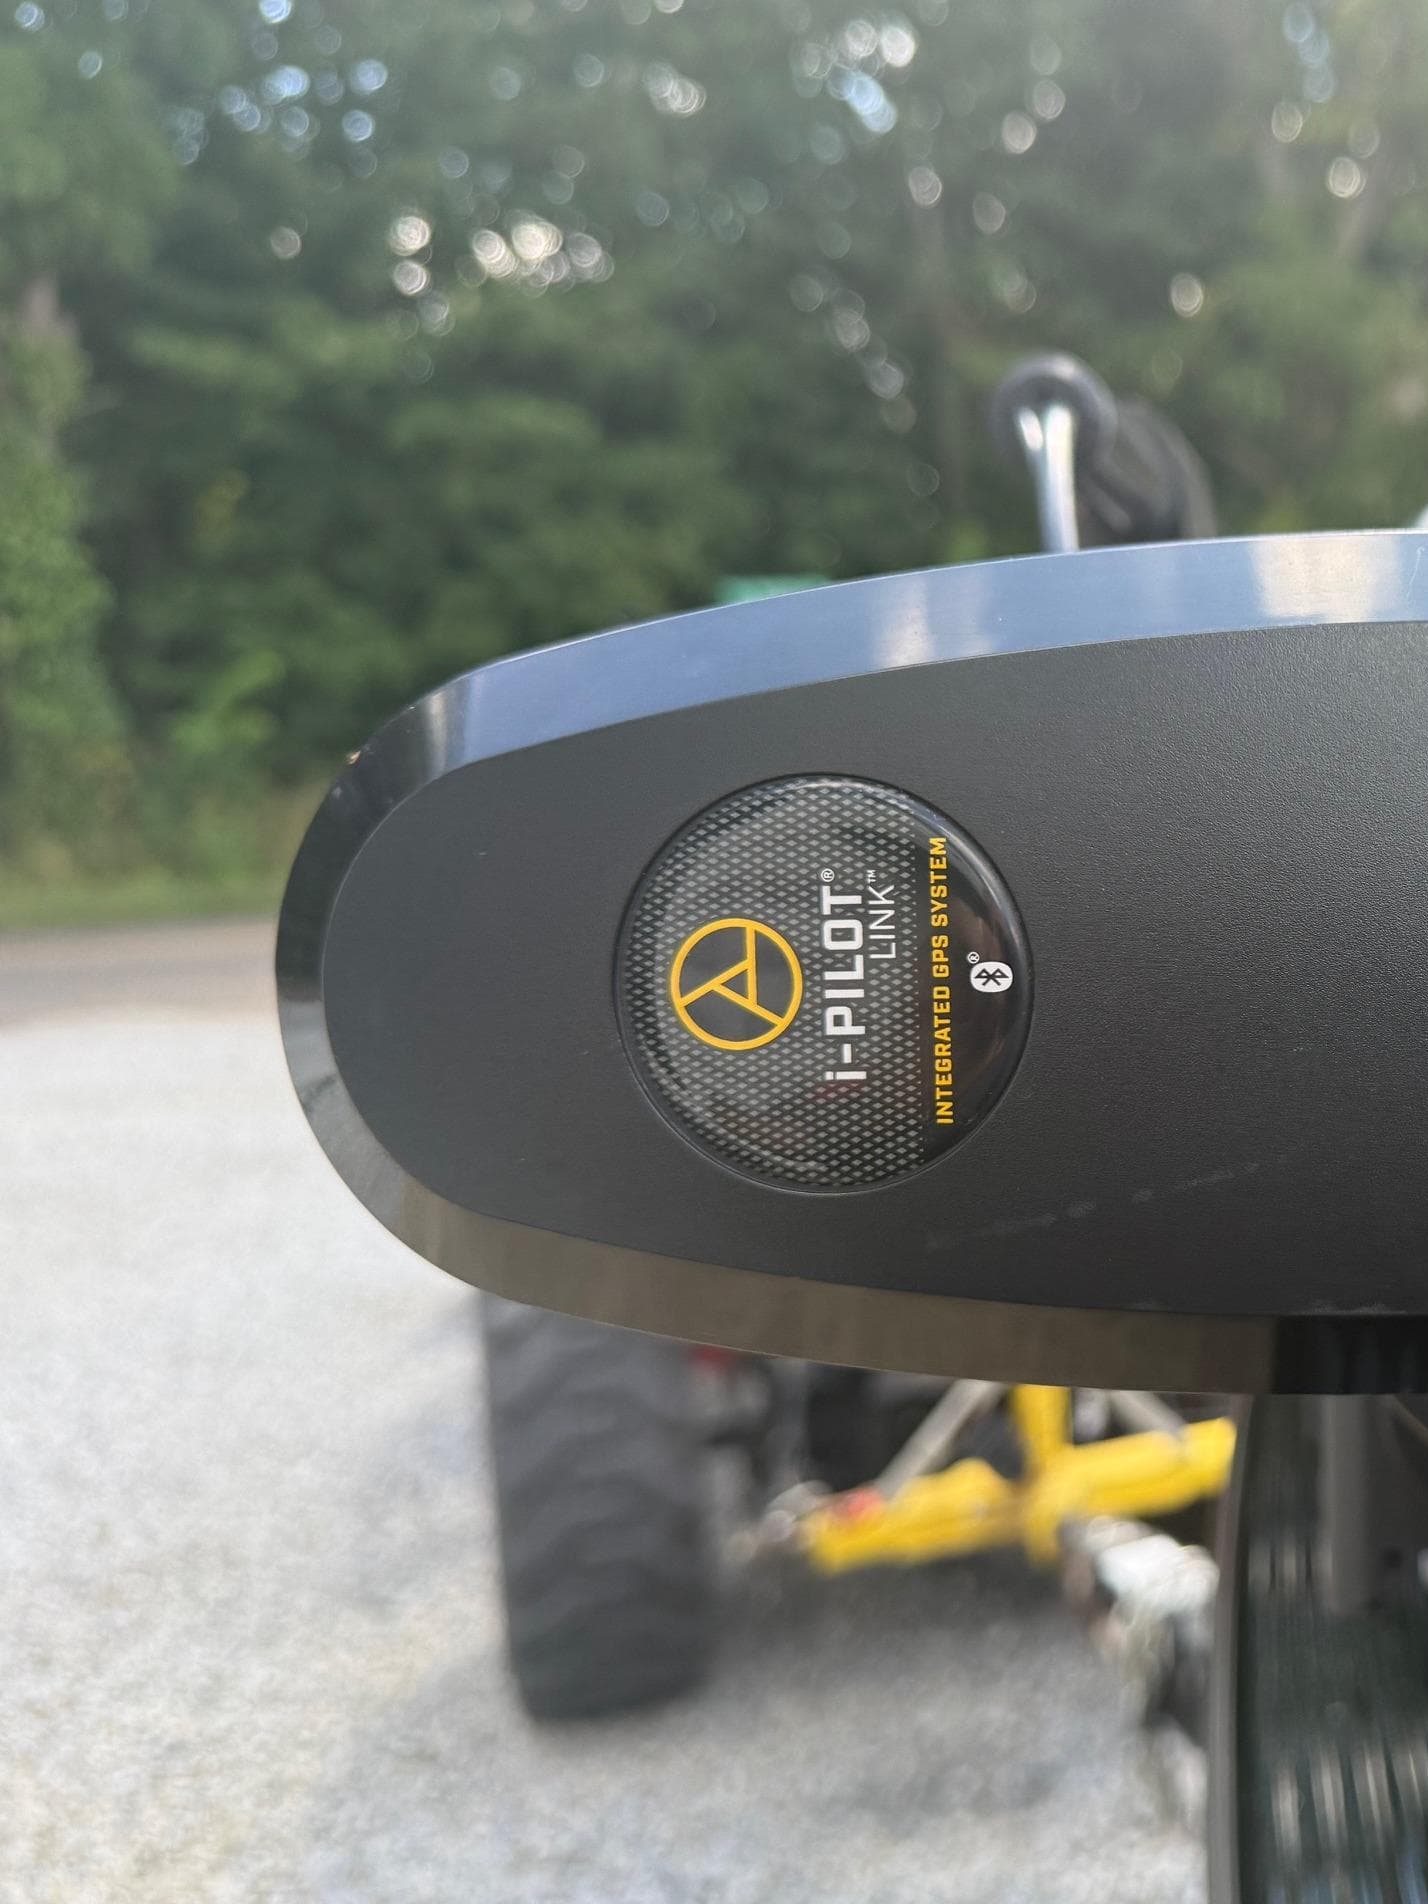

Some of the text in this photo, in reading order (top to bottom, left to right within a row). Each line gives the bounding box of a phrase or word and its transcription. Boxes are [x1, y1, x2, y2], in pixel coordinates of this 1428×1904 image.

[928, 837, 954, 1125] INTEGRATED GPS SYSTEM
